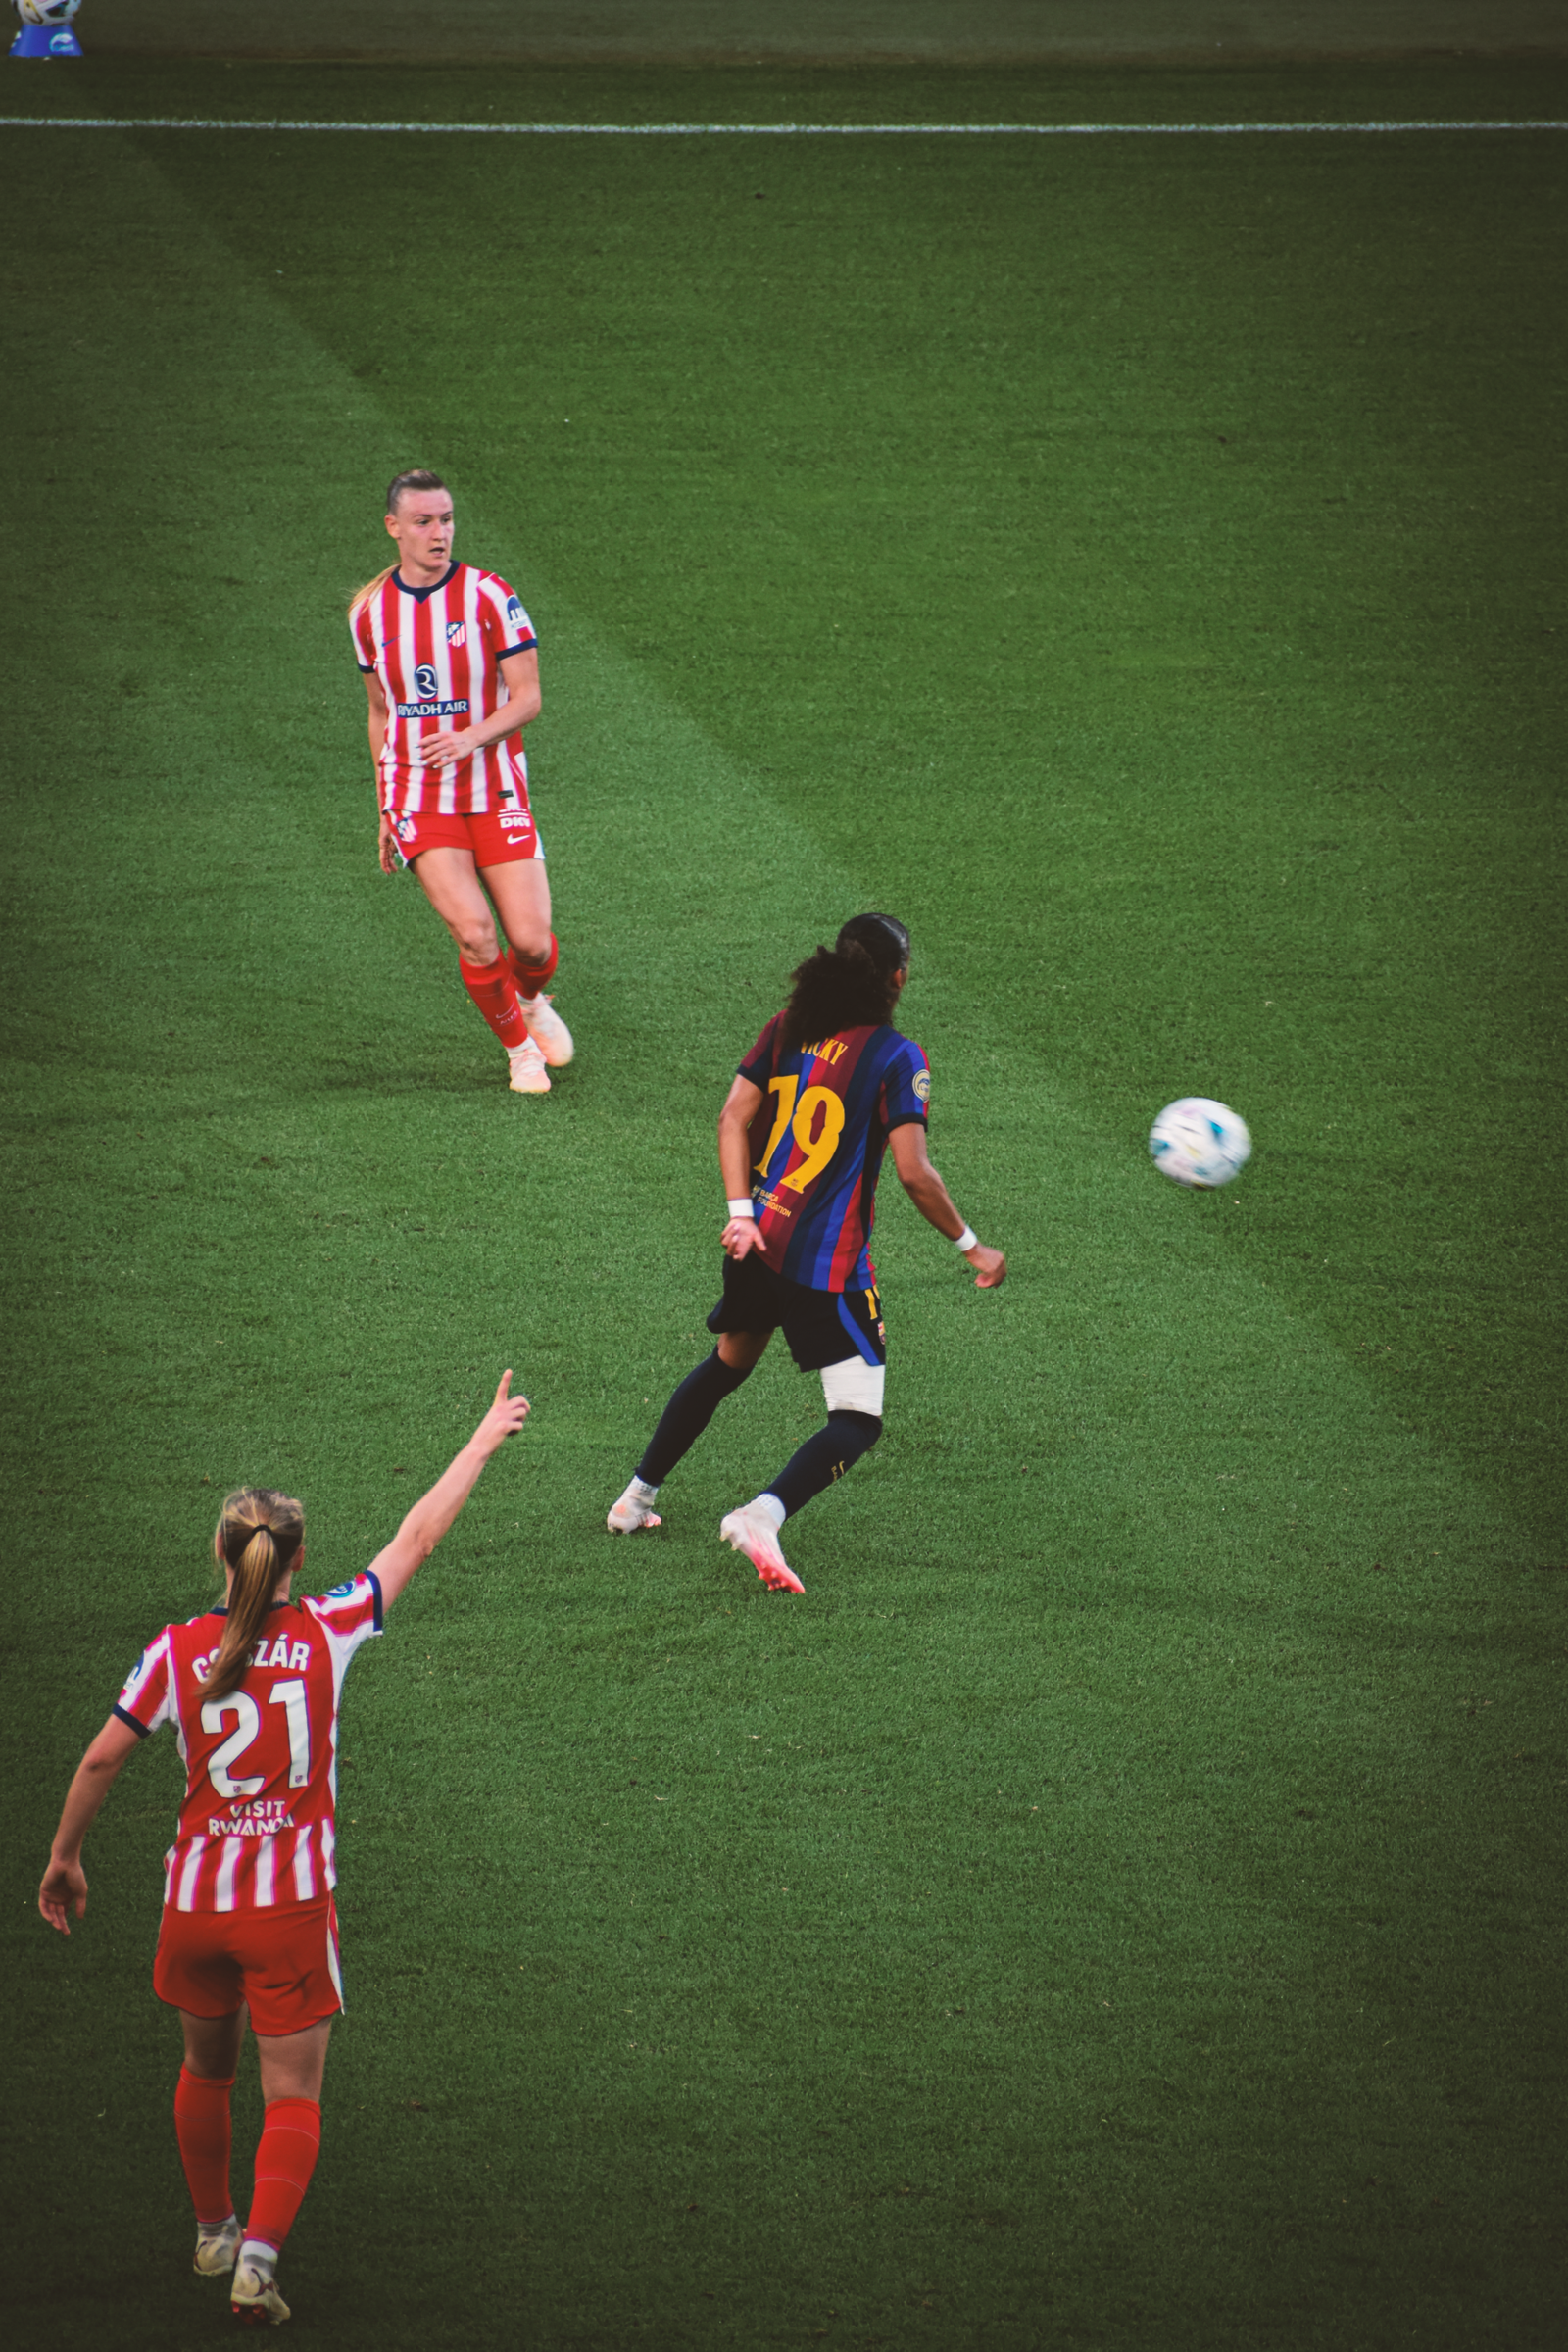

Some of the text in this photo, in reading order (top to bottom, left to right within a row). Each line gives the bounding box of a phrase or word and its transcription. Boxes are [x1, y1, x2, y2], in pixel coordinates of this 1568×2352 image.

[397, 700, 468, 716] RIYADH AIR
[753, 1074, 845, 1194] 19
[200, 1678, 312, 1799] 21
[229, 1800, 285, 1818] VISIT
